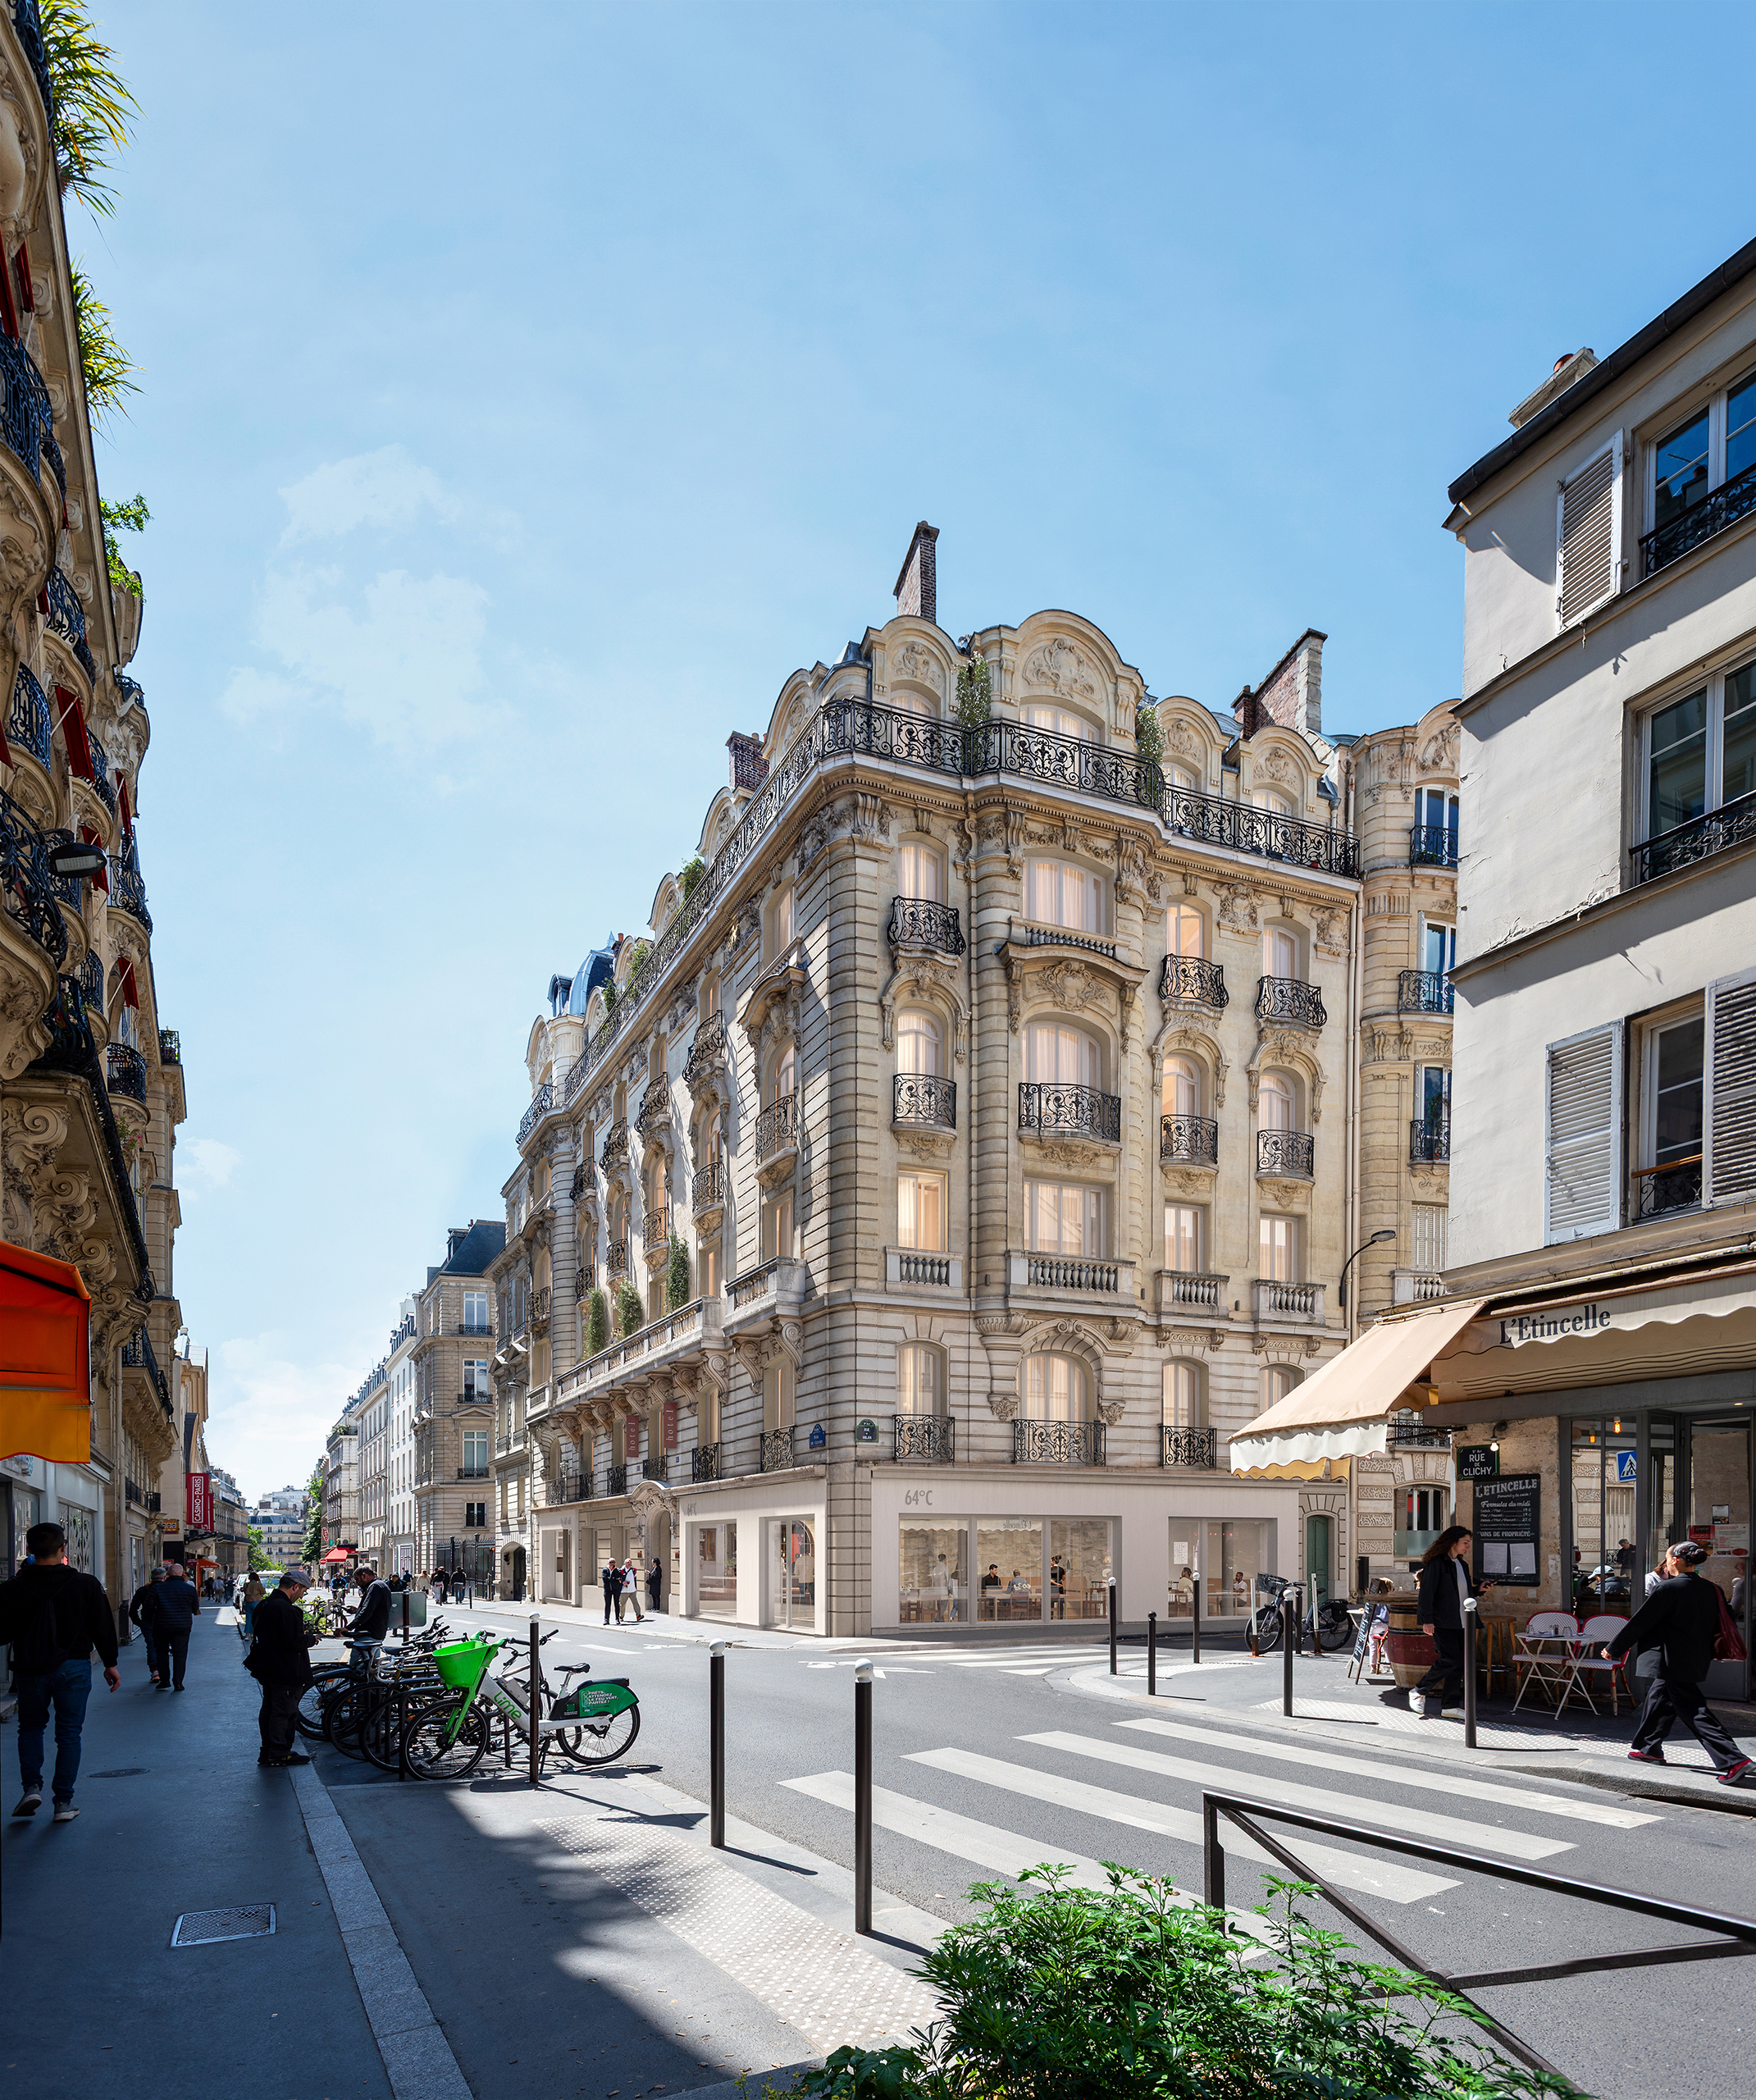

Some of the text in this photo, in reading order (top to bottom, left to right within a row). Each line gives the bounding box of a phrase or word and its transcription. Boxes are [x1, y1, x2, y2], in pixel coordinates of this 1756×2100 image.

[1499, 1303, 1611, 1344] L'Etincelle
[1469, 1453, 1485, 1463] RUE
[1462, 1466, 1493, 1477] CLICHY
[905, 1490, 933, 1506] 64°C
